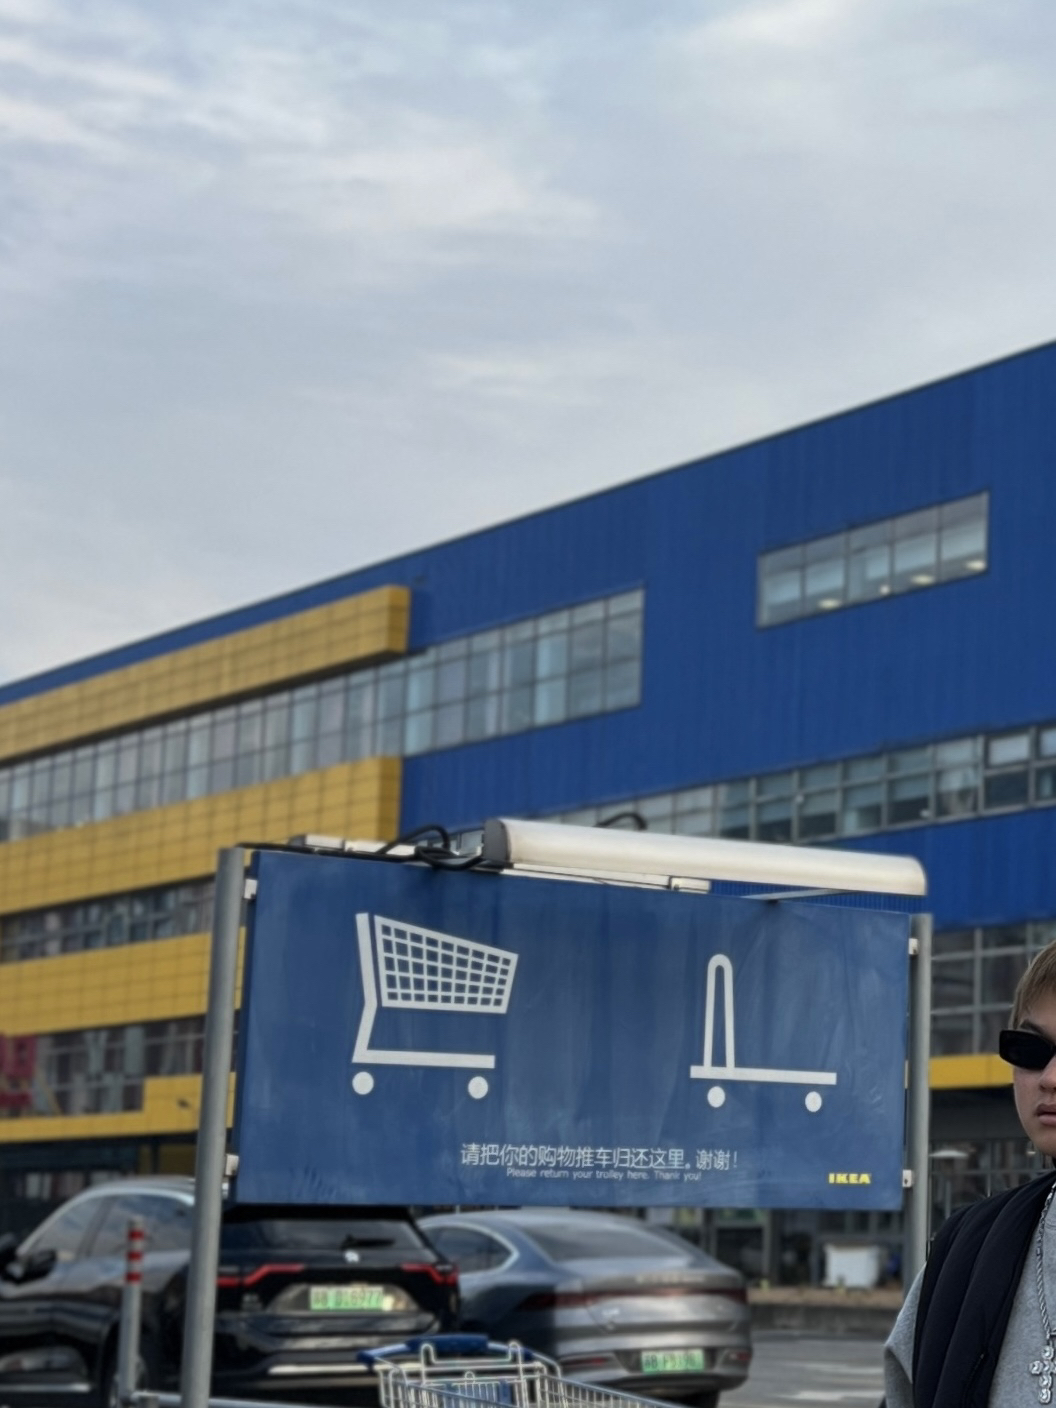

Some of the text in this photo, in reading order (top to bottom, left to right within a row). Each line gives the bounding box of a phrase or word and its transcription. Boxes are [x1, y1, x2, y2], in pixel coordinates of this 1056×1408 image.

[506, 1167, 537, 1178] Please
[540, 1168, 569, 1178] return
[572, 1170, 594, 1180] your
[595, 1170, 624, 1181] trolley
[654, 1170, 680, 1180] Thank
[828, 1173, 871, 1184] IKEA
